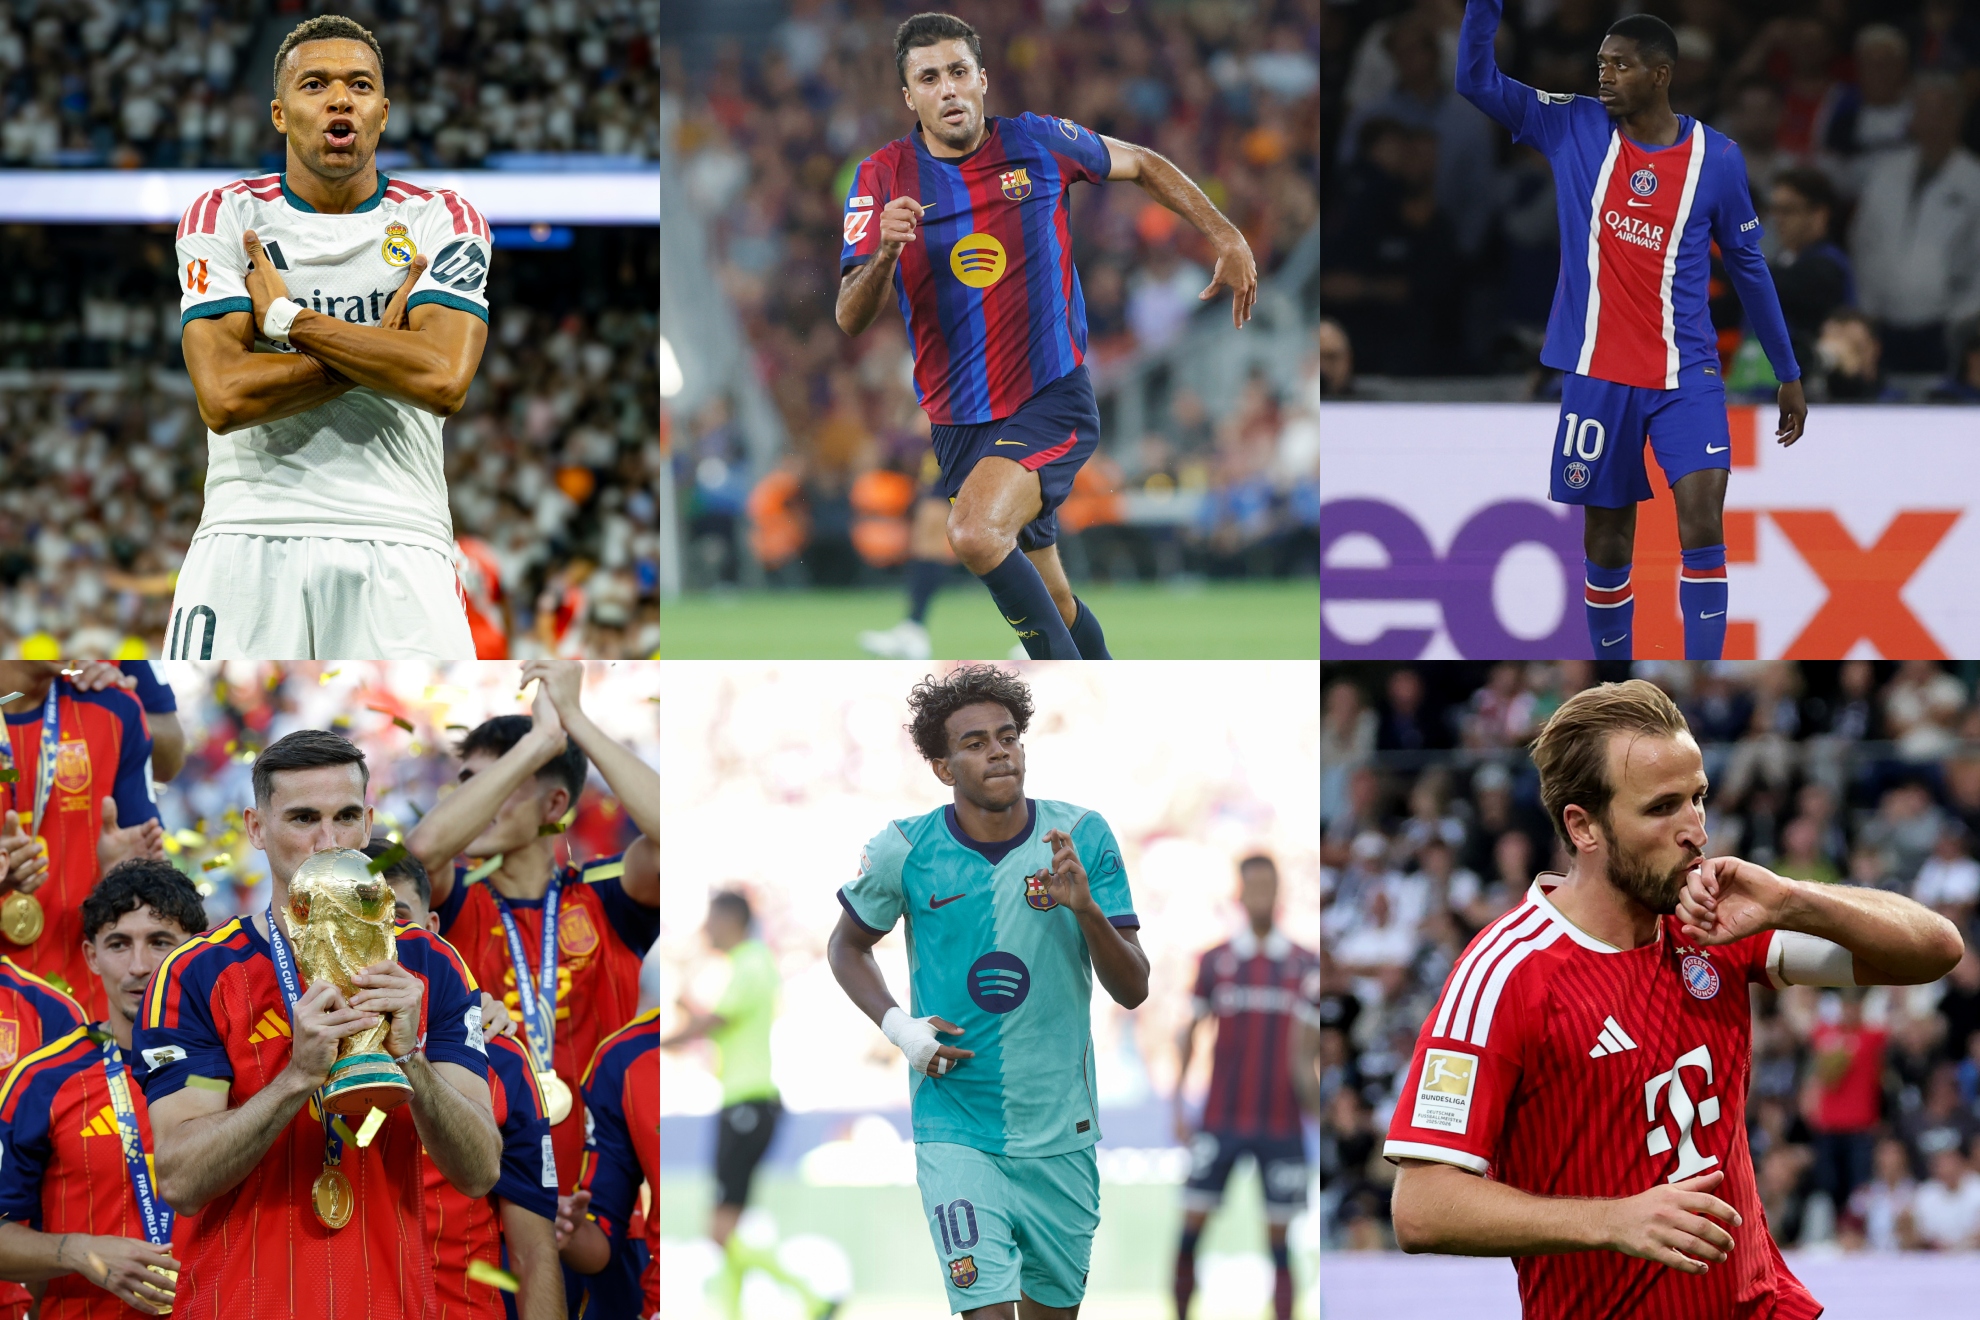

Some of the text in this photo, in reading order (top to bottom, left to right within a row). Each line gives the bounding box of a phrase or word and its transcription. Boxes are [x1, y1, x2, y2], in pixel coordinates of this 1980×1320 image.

[1605, 210, 1664, 242] QATAR
[1615, 229, 1661, 251] AIRWAYS
[430, 240, 487, 291] hp
[1563, 412, 1606, 462] 10
[1320, 404, 1965, 660] edEx
[170, 604, 216, 660] 10
[546, 916, 555, 934] CUP
[272, 931, 288, 970] WORLD
[282, 970, 295, 991] CUP
[508, 929, 524, 963] WORLD
[516, 962, 529, 982] CUP
[545, 934, 555, 967] WORLD
[544, 967, 553, 988] FIFA
[1421, 1094, 1465, 1105] BUNDESLIGA
[1427, 1109, 1455, 1117] DEUTSCHER
[136, 1173, 149, 1198] FIFA
[142, 1197, 158, 1236] WORLD
[934, 1198, 980, 1256] 10
